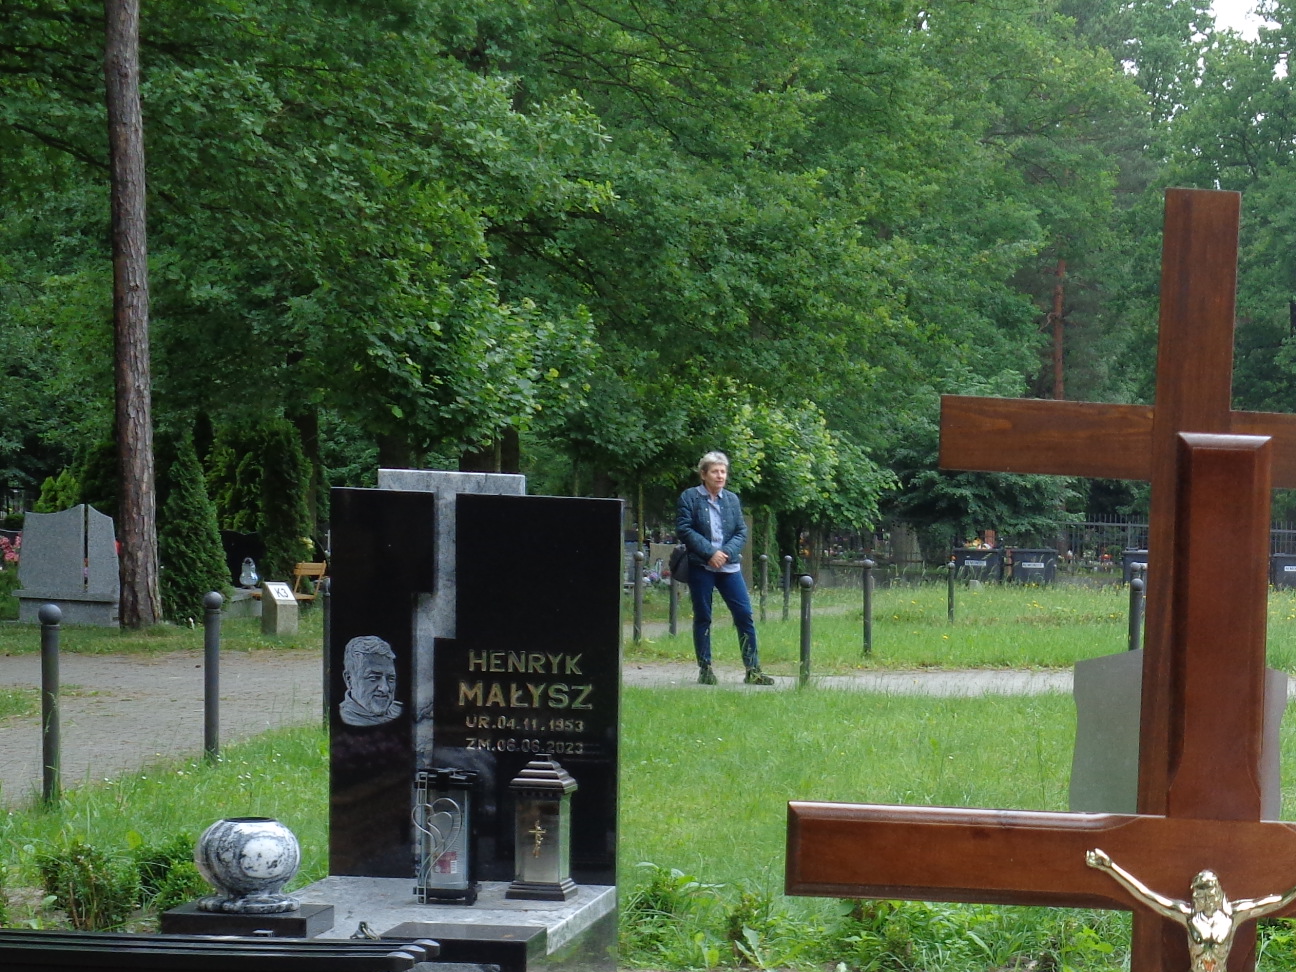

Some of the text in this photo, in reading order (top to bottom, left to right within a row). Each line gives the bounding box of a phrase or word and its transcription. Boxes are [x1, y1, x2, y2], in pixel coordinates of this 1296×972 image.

[274, 587, 289, 598] K3
[468, 649, 583, 675] HENRYK
[458, 679, 594, 710] MAŁYSZ
